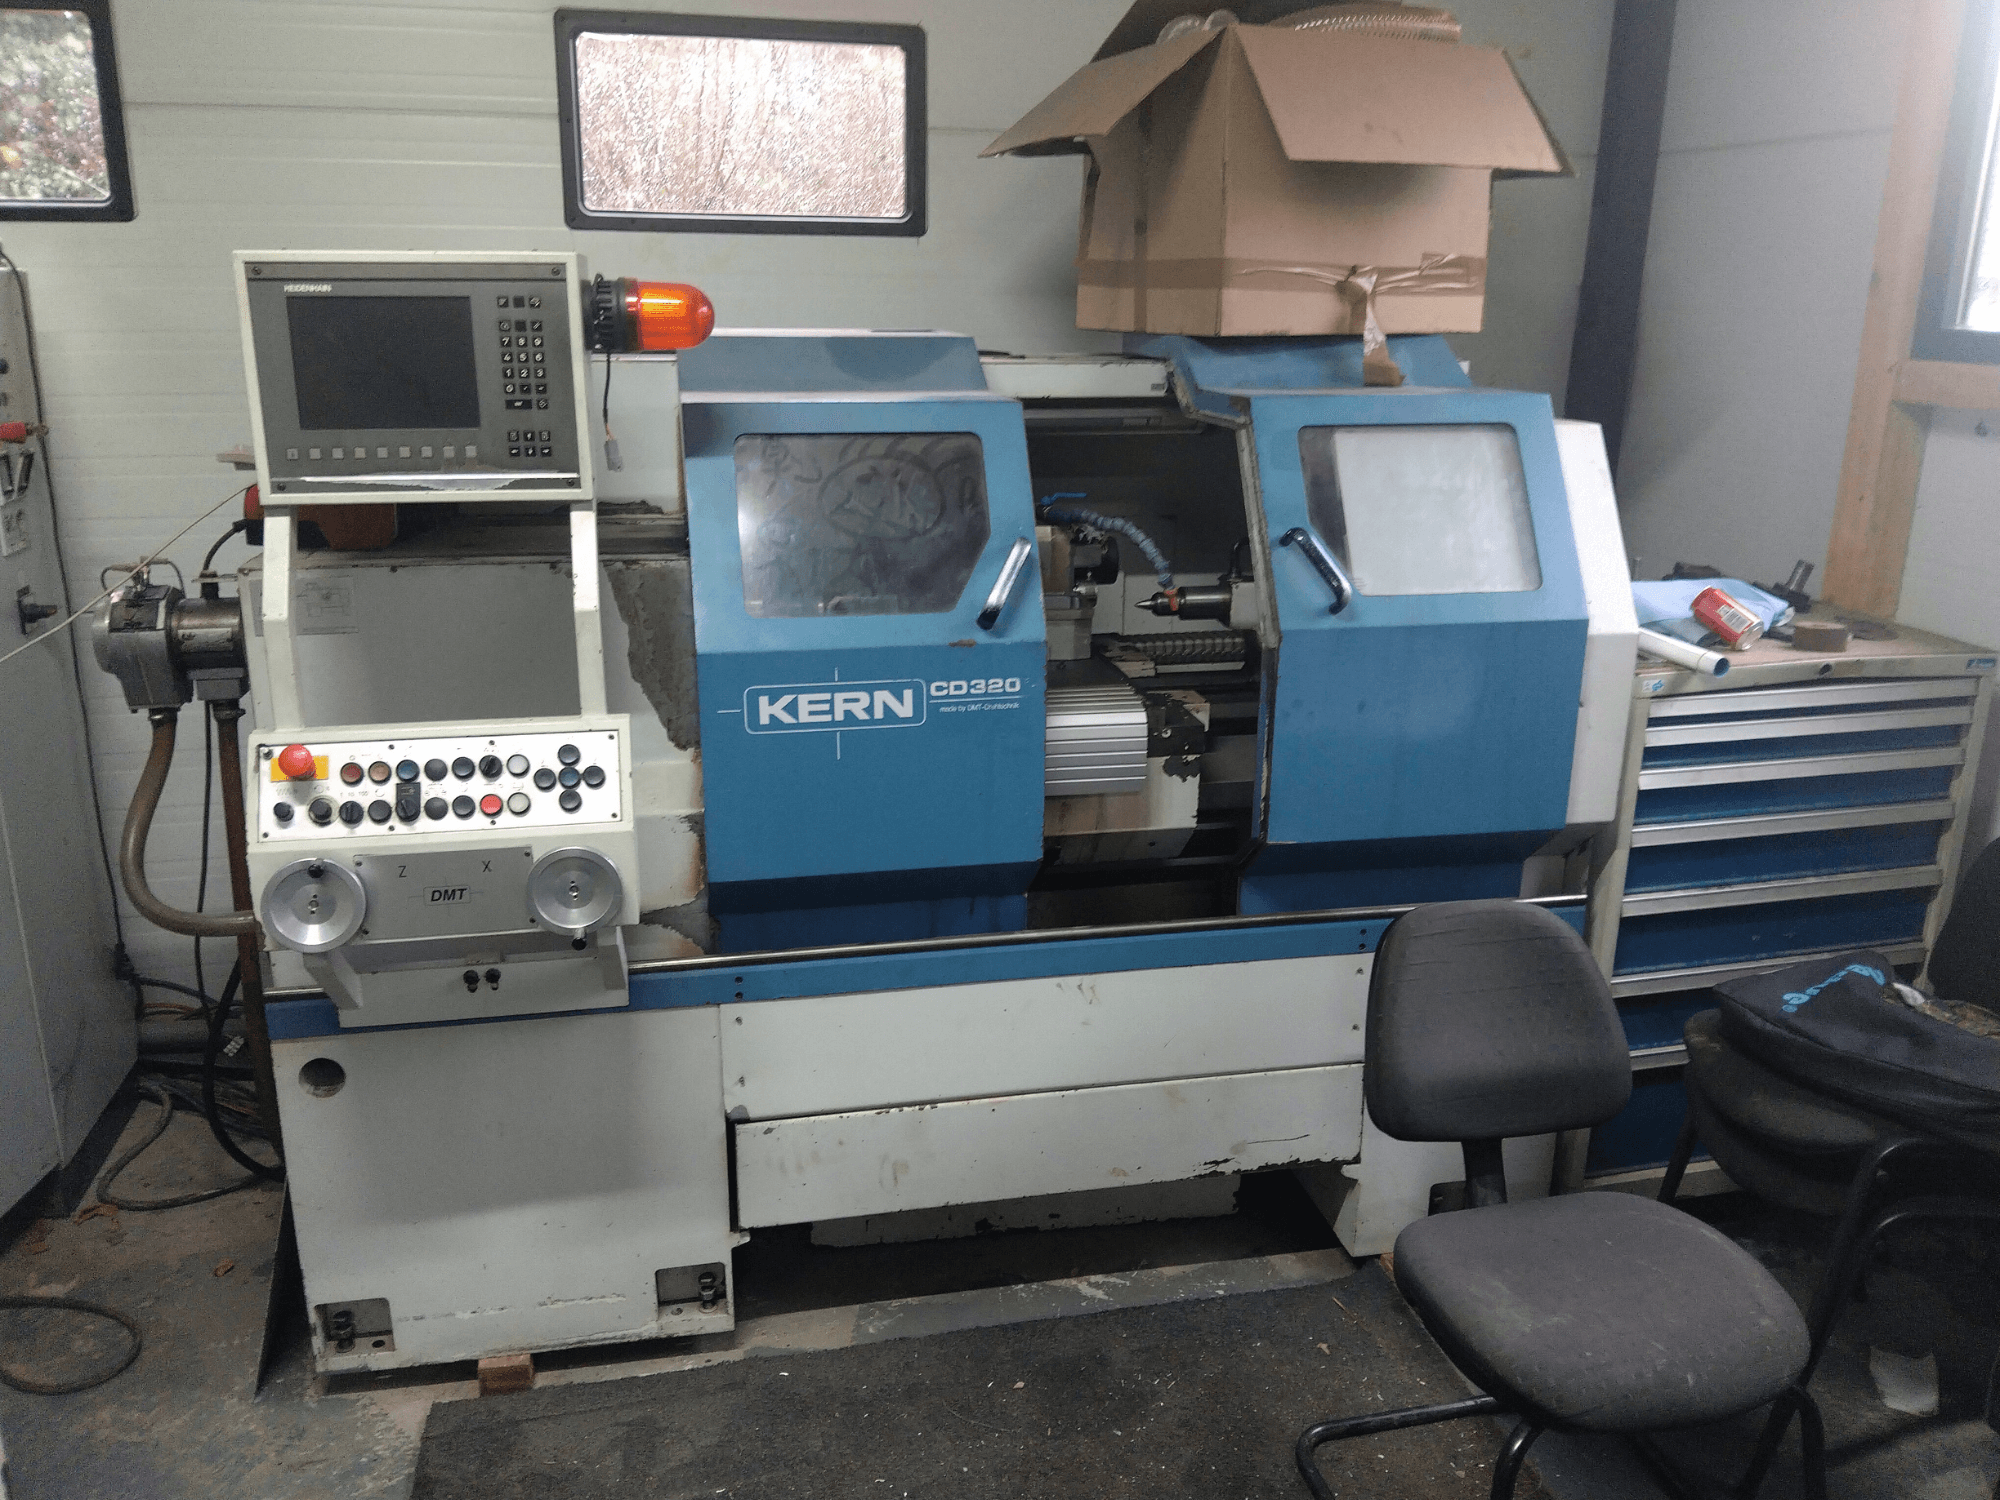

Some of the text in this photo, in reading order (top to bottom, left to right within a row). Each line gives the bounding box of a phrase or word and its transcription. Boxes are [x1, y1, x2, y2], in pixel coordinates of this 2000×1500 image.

[502, 336, 510, 346] 7
[520, 368, 529, 378] 2
[536, 368, 544, 377] 3
[929, 677, 1021, 697] CD320
[758, 688, 914, 726] KERN
[957, 705, 966, 713] by
[397, 860, 493, 878] Z X
[430, 888, 468, 902] DMT
